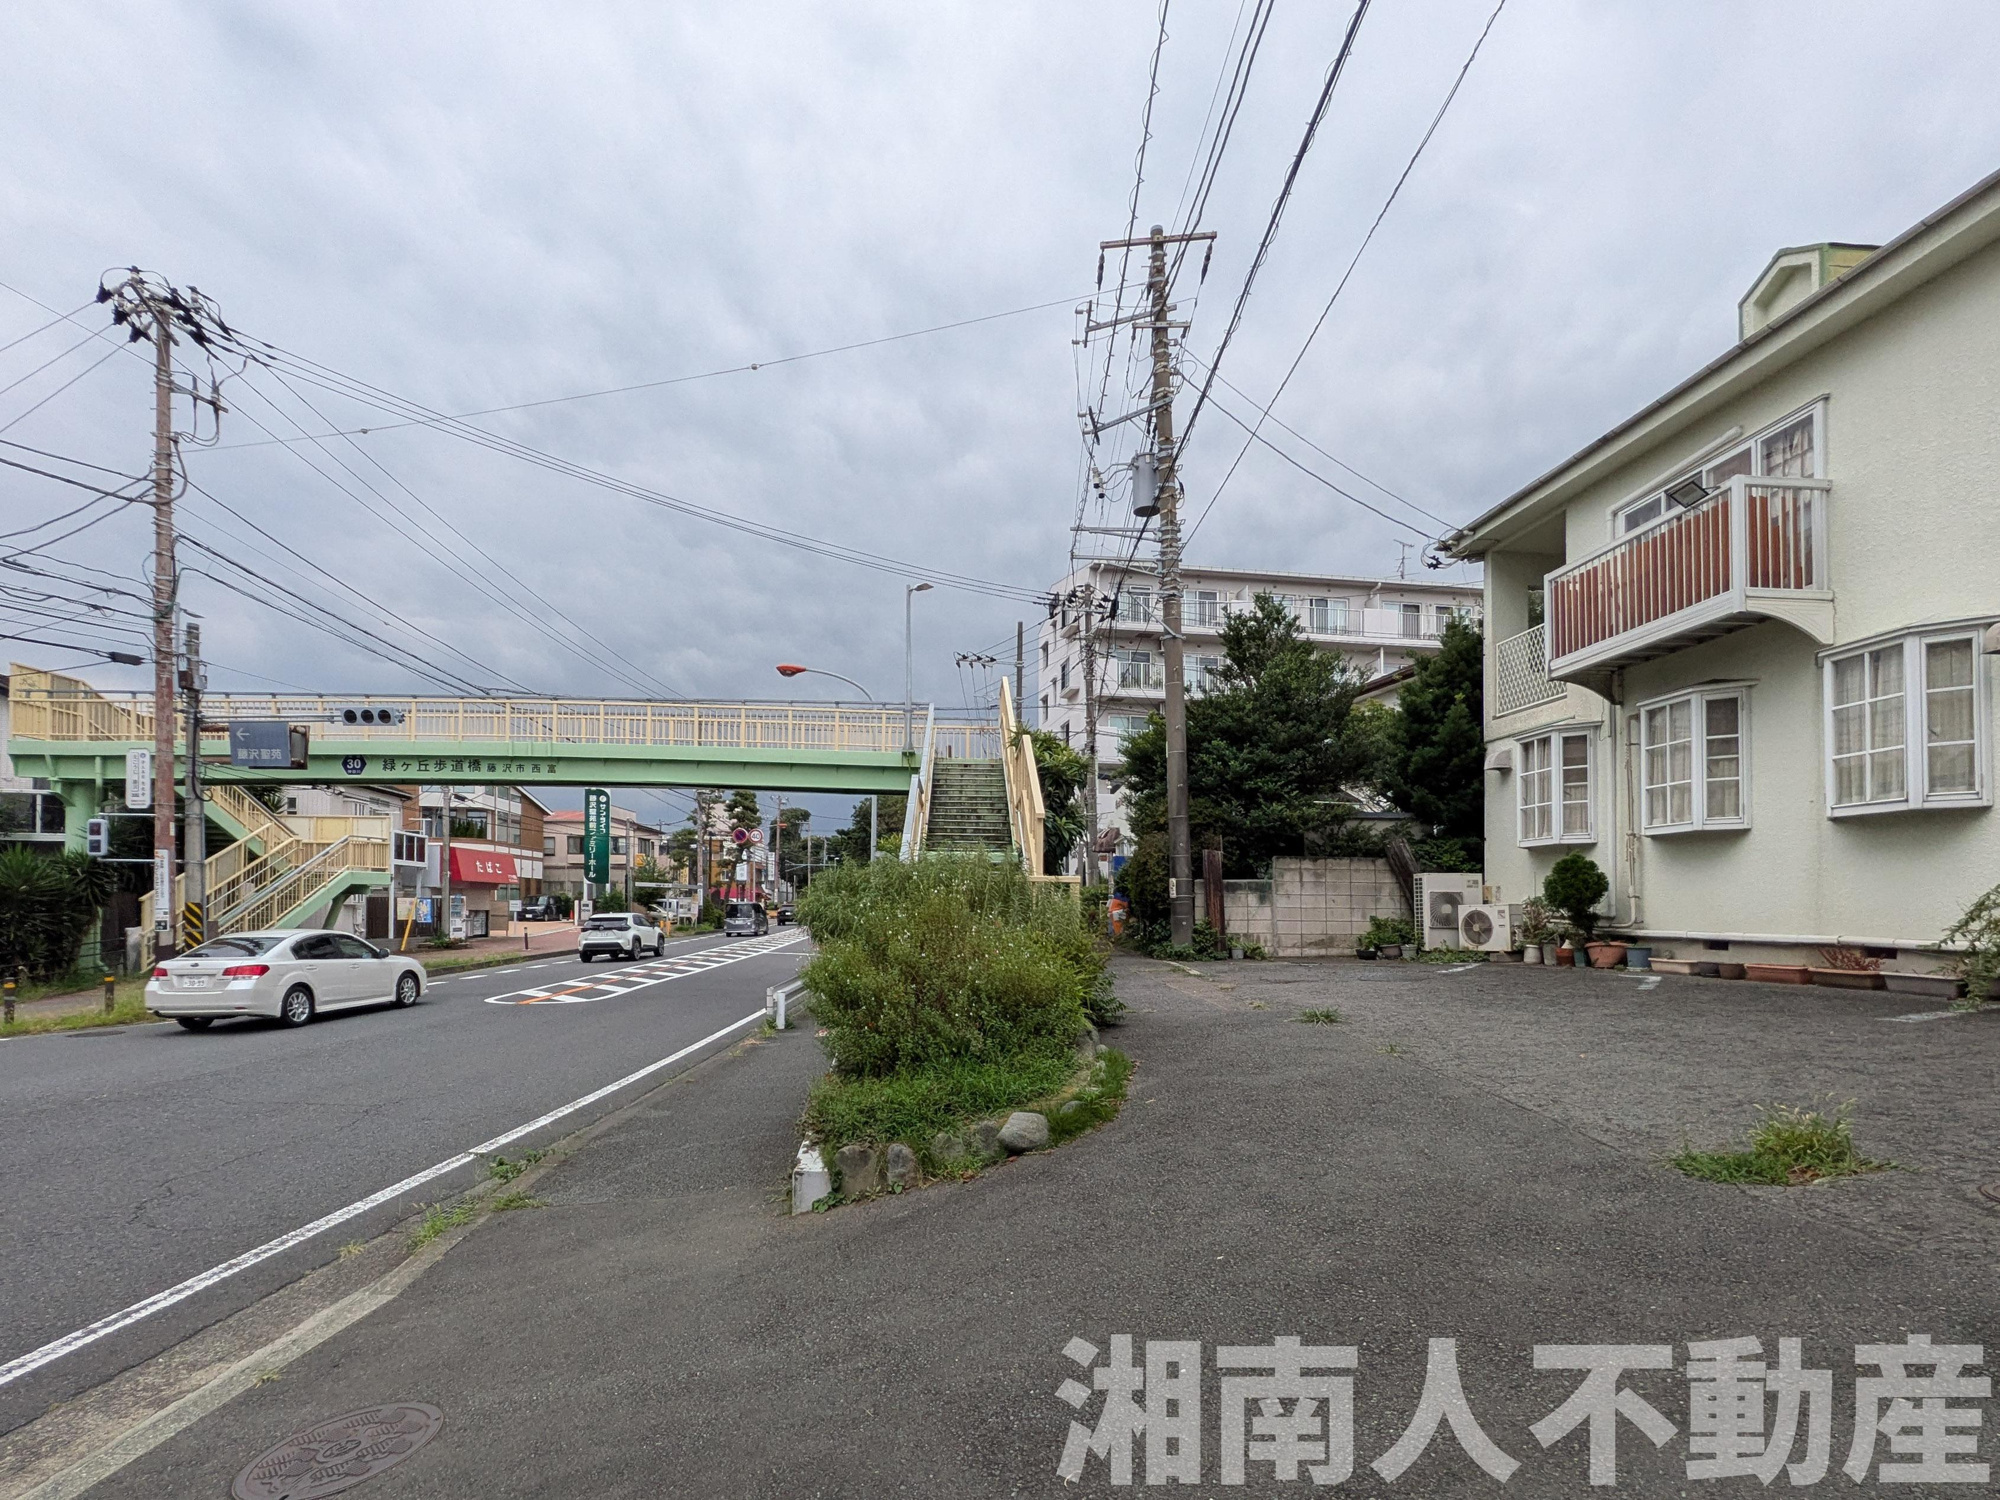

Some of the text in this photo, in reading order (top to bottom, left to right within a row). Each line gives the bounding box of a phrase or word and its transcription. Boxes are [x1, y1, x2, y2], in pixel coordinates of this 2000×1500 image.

[237, 748, 282, 760] 藤沢聖苑
[346, 759, 361, 769] 30
[486, 763, 557, 774] 藤沢市西富
[476, 860, 502, 874] たばこ
